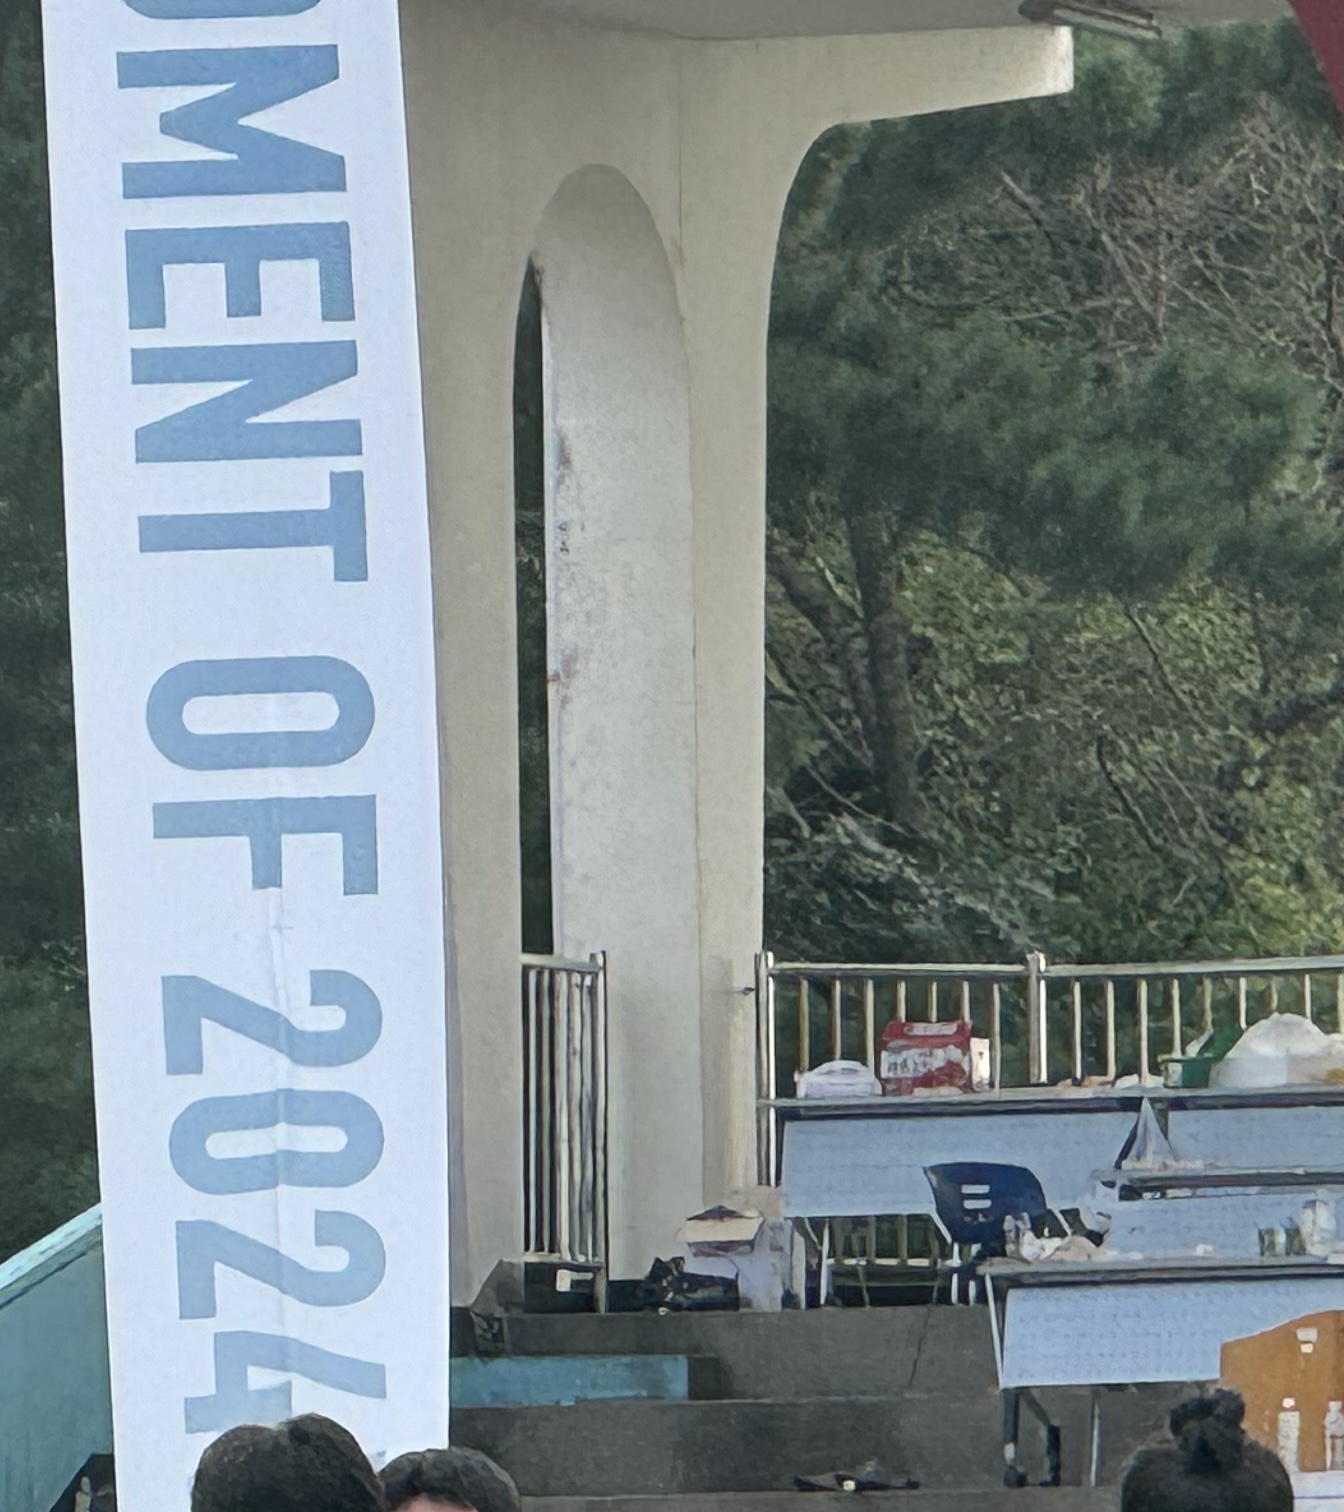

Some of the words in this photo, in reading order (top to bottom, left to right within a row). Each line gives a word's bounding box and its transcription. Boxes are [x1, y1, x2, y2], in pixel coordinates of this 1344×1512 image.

[116, 0, 369, 583] MENT
[146, 655, 379, 896] OF
[160, 968, 388, 1434] 2024
